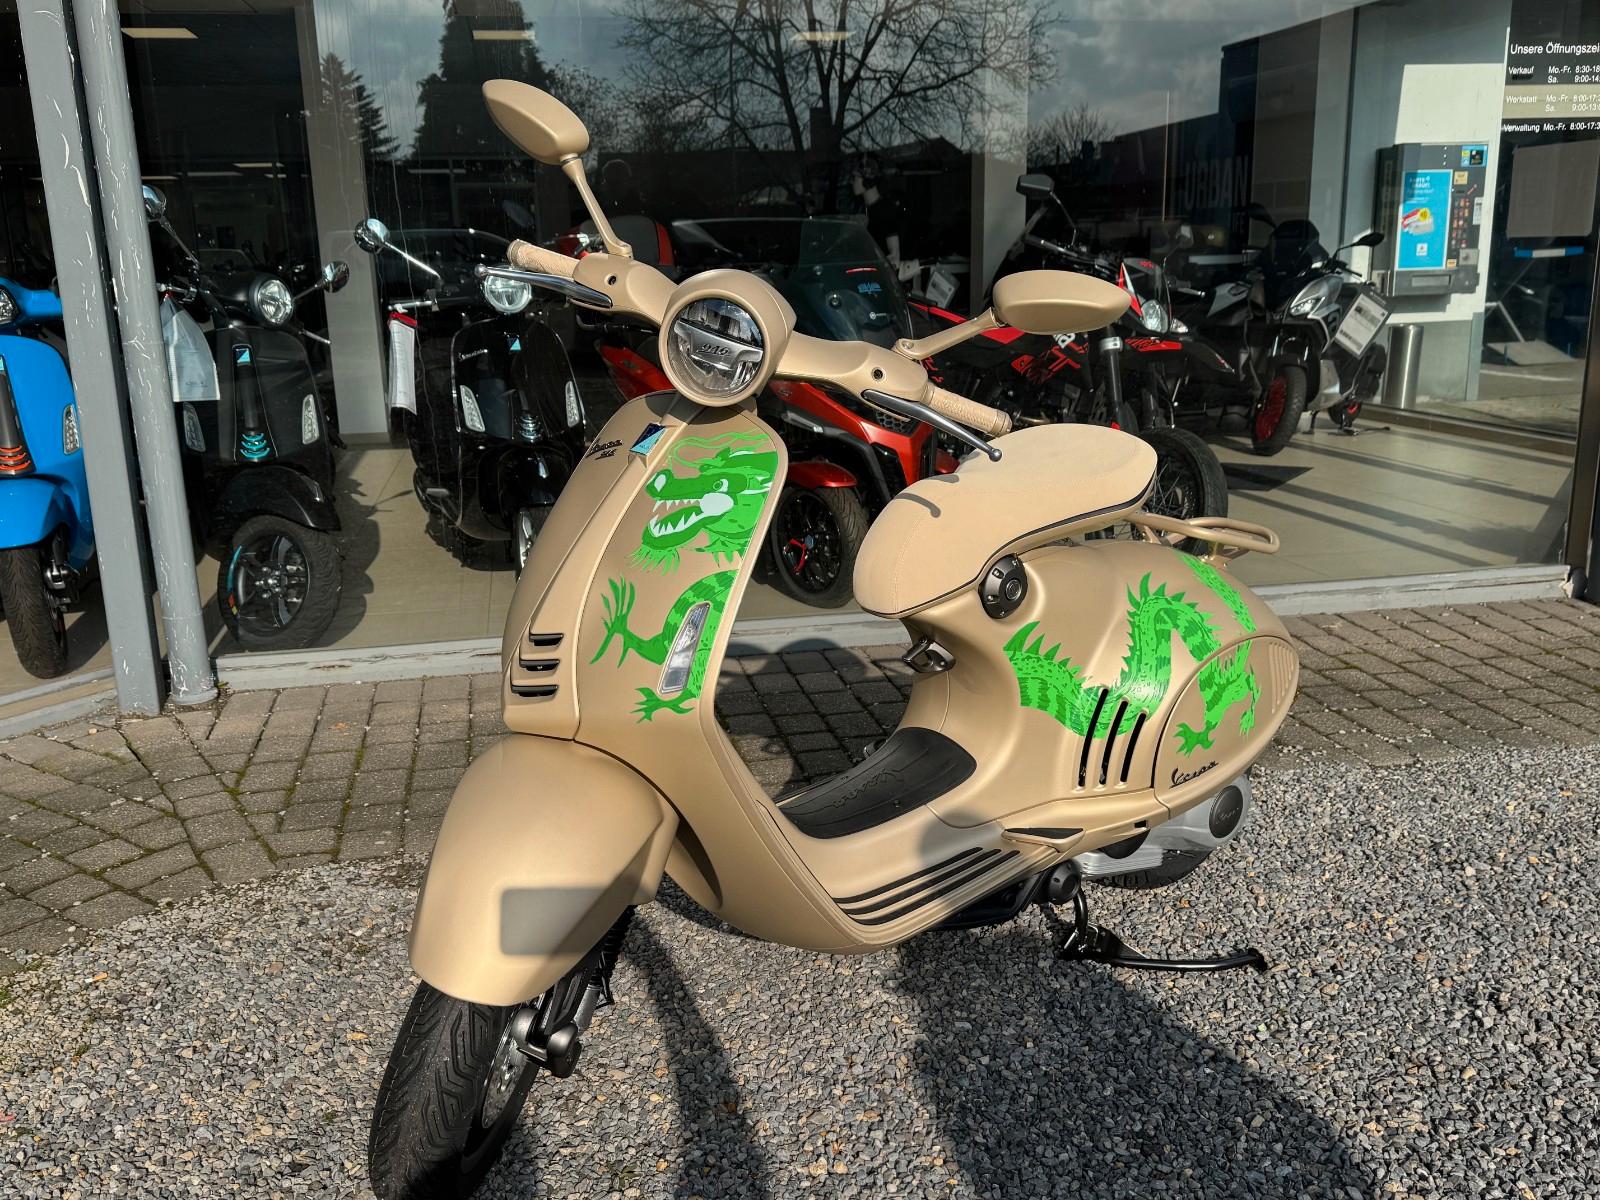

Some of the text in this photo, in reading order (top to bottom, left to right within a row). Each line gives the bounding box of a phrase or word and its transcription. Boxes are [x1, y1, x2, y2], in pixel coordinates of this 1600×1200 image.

[1510, 44, 1543, 54] Unsere
[1508, 66, 1534, 75] Verkauf
[1548, 66, 1572, 74] Mo.-Fr.
[1506, 95, 1537, 104] Werkstatt
[1503, 123, 1540, 133] Verwaltung
[1543, 123, 1567, 131] Mo.-Fr.
[1169, 761, 1219, 789] Vespa
